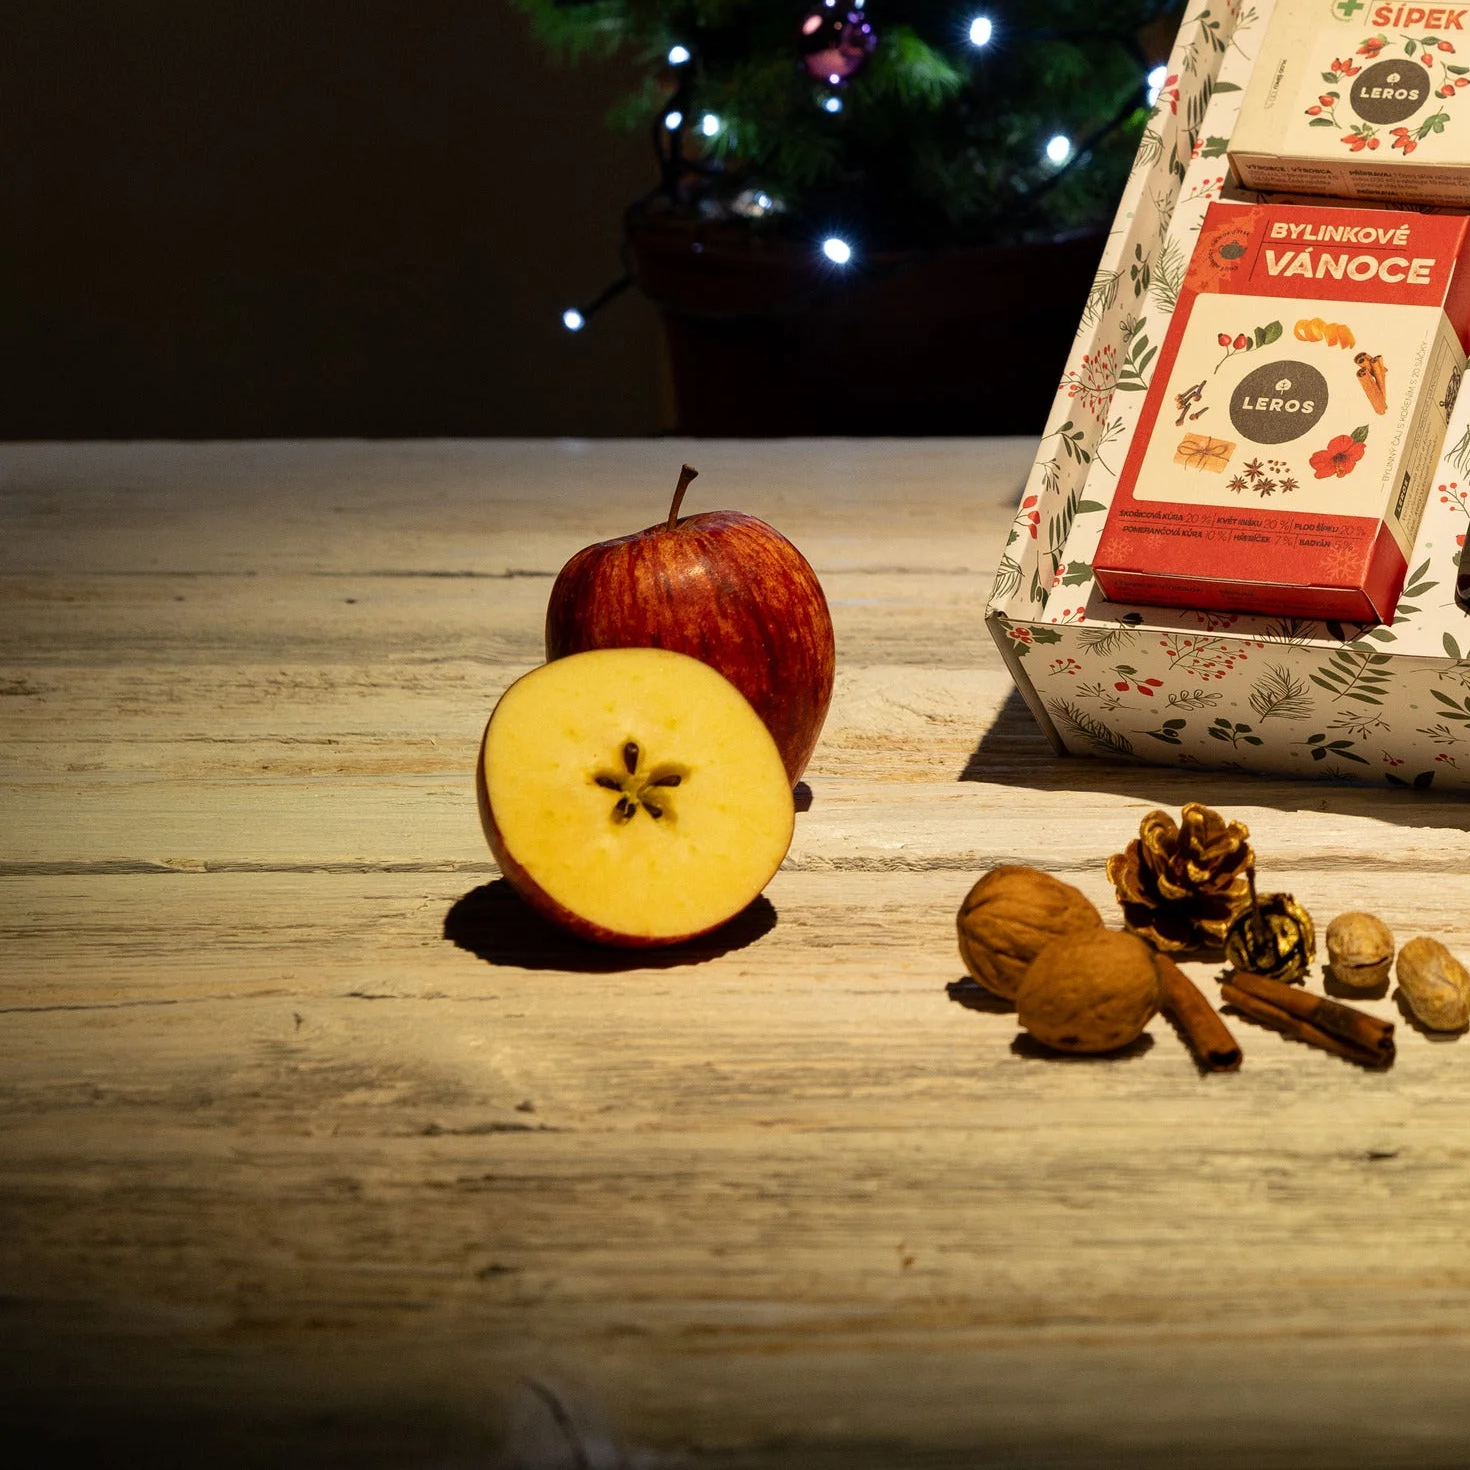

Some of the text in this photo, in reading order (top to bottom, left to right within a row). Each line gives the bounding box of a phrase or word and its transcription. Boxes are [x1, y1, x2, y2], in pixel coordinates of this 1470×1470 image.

[1371, 2, 1469, 30] ŠÍPEK
[1359, 86, 1420, 101] LEROS
[1270, 222, 1411, 245] BYLINKOVÉ
[1265, 247, 1436, 284] VÁNOCE
[1241, 396, 1316, 414] LEROS
[1185, 512, 1200, 523] 20
[1201, 514, 1212, 524] %
[1216, 516, 1238, 525] KVĚT
[1263, 519, 1278, 529] 20
[1280, 520, 1290, 531] %
[1299, 538, 1331, 548] BADYÁN
